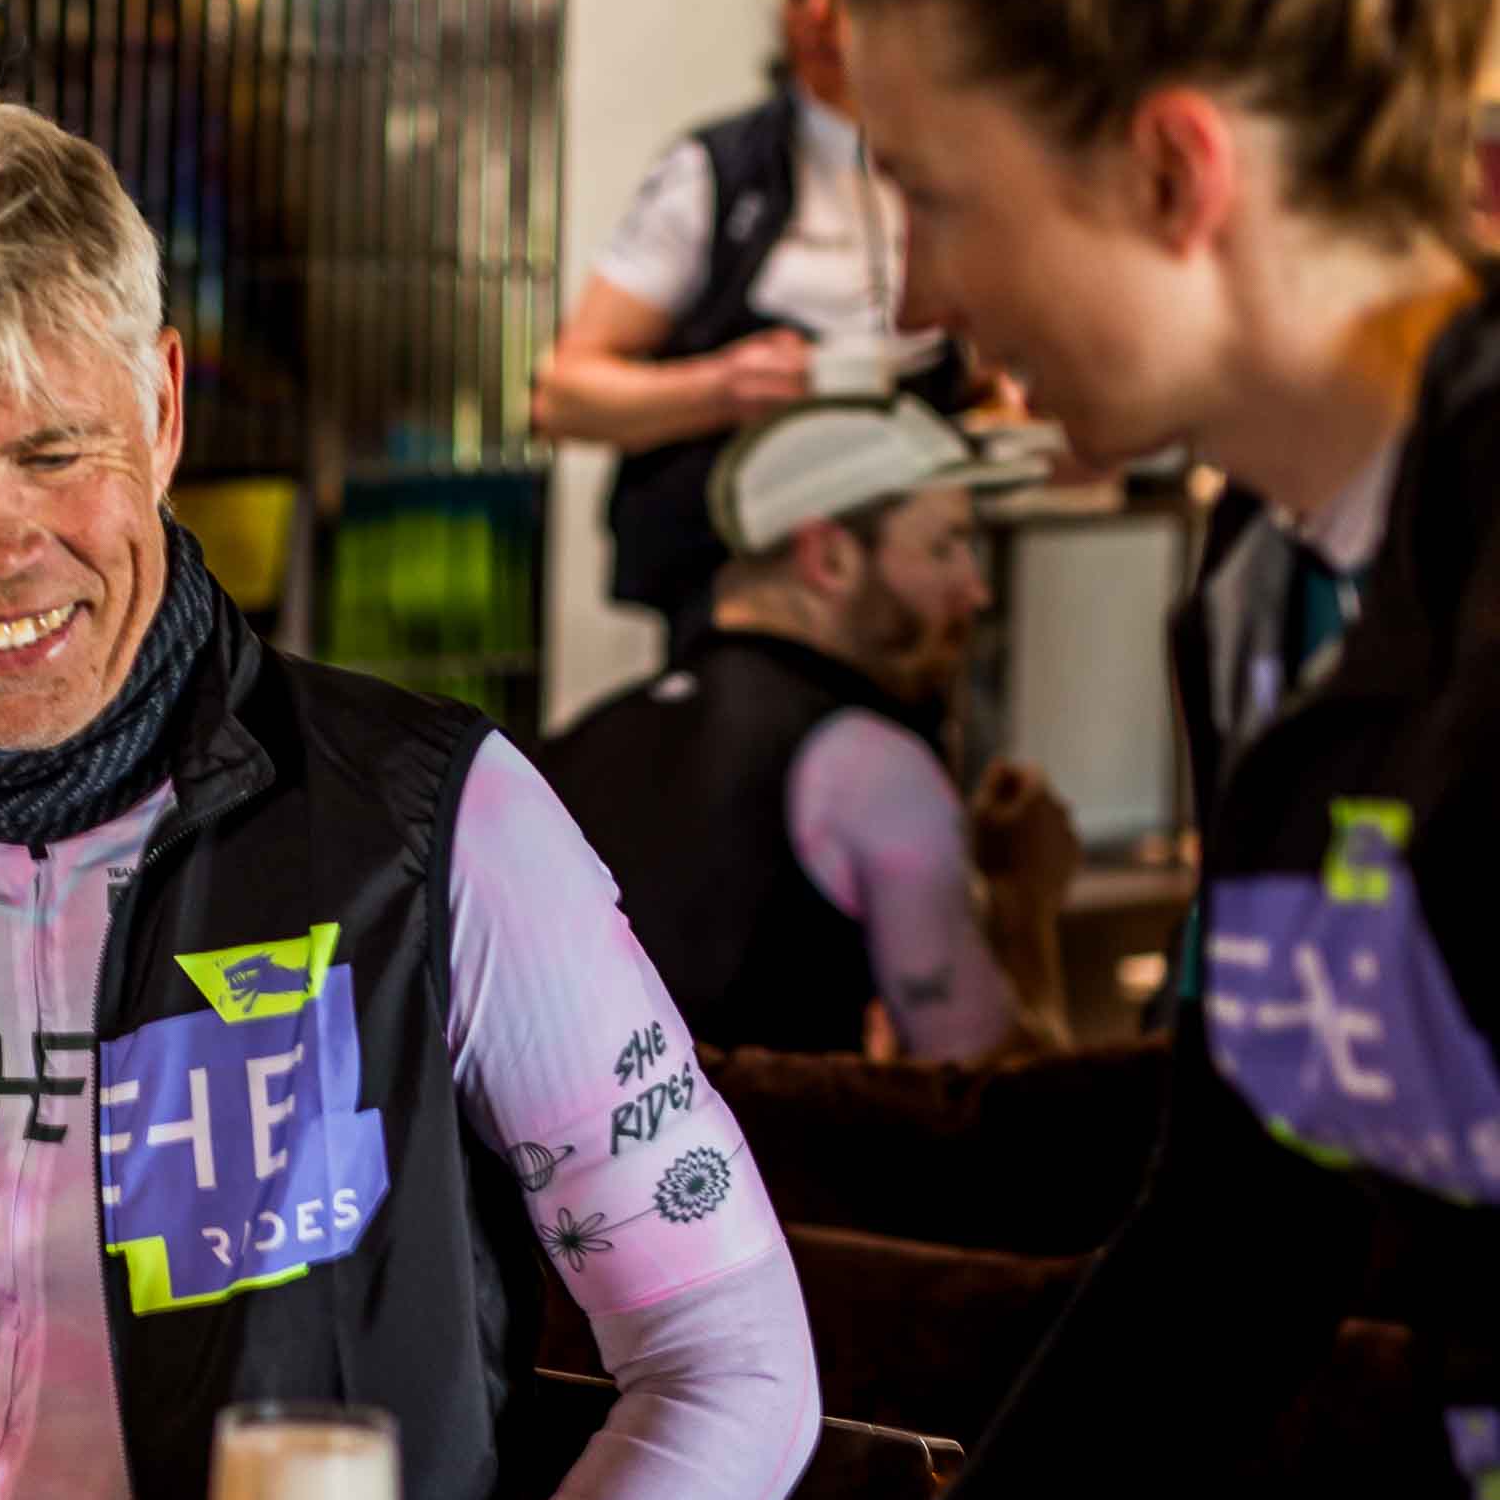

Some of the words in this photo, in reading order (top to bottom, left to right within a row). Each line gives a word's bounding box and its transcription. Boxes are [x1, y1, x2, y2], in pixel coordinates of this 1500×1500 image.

[614, 1020, 666, 1087] SHE
[610, 1062, 695, 1156] RIDES
[201, 1187, 361, 1268] RIDES
